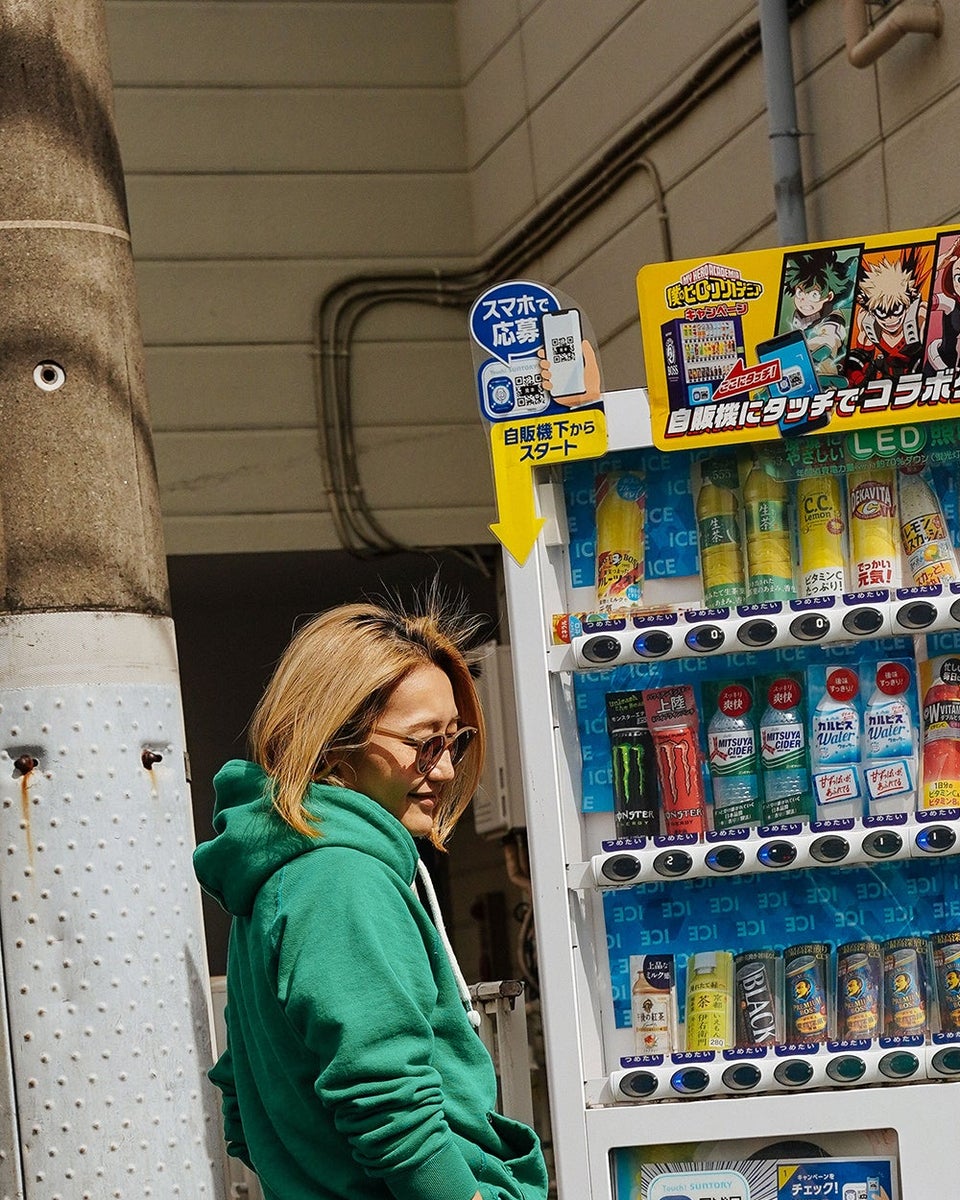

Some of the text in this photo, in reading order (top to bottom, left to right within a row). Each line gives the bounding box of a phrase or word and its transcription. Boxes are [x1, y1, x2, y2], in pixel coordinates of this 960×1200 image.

[482, 294, 549, 321] スマホで
[685, 302, 748, 320] キャンペーン
[492, 317, 540, 347] 応募
[719, 365, 777, 392] ここにタッチ!
[504, 420, 595, 446] 自販機下から
[854, 426, 919, 455] LED
[519, 440, 578, 462] スタート
[786, 449, 844, 467] やさしい
[804, 494, 832, 514] C.C.
[851, 485, 892, 511] DEKAVITA
[759, 503, 772, 531] 生茶
[804, 510, 832, 522] Lemon
[709, 517, 724, 543] 生茶
[669, 532, 697, 546] ICE
[649, 559, 677, 574] ICE
[857, 560, 891, 573] でっかい
[805, 570, 842, 586] ビタミンC
[858, 569, 892, 588] 元気!
[805, 581, 842, 596] たっぷり!
[742, 601, 778, 612] つめたい
[638, 613, 674, 624] つめたい
[829, 683, 854, 693] すっきり!
[879, 677, 904, 687] すっきり!
[773, 691, 793, 704] 爽快
[656, 695, 686, 714] 上陸
[723, 699, 743, 711] 爽快
[818, 720, 855, 731] カルピス
[868, 714, 905, 726] カルピス
[766, 731, 801, 741] MITSUYA
[817, 731, 856, 746] Water
[868, 725, 906, 740] Water
[718, 736, 753, 747] MITSUYA
[775, 740, 801, 749] CIDER
[727, 745, 753, 756] CIDER
[921, 808, 957, 818] つめたい
[762, 823, 797, 833] つめたい
[814, 818, 850, 828] つめたい
[659, 833, 694, 843] つめたい
[648, 961, 669, 969] 上品な
[697, 995, 711, 1008] 茶
[742, 965, 777, 1043] BLACK
[884, 1034, 920, 1043] つめたい
[728, 1046, 763, 1056] つめたい
[662, 1180, 733, 1193] Touch! SUNTORY
[791, 1181, 839, 1196] チェック!
